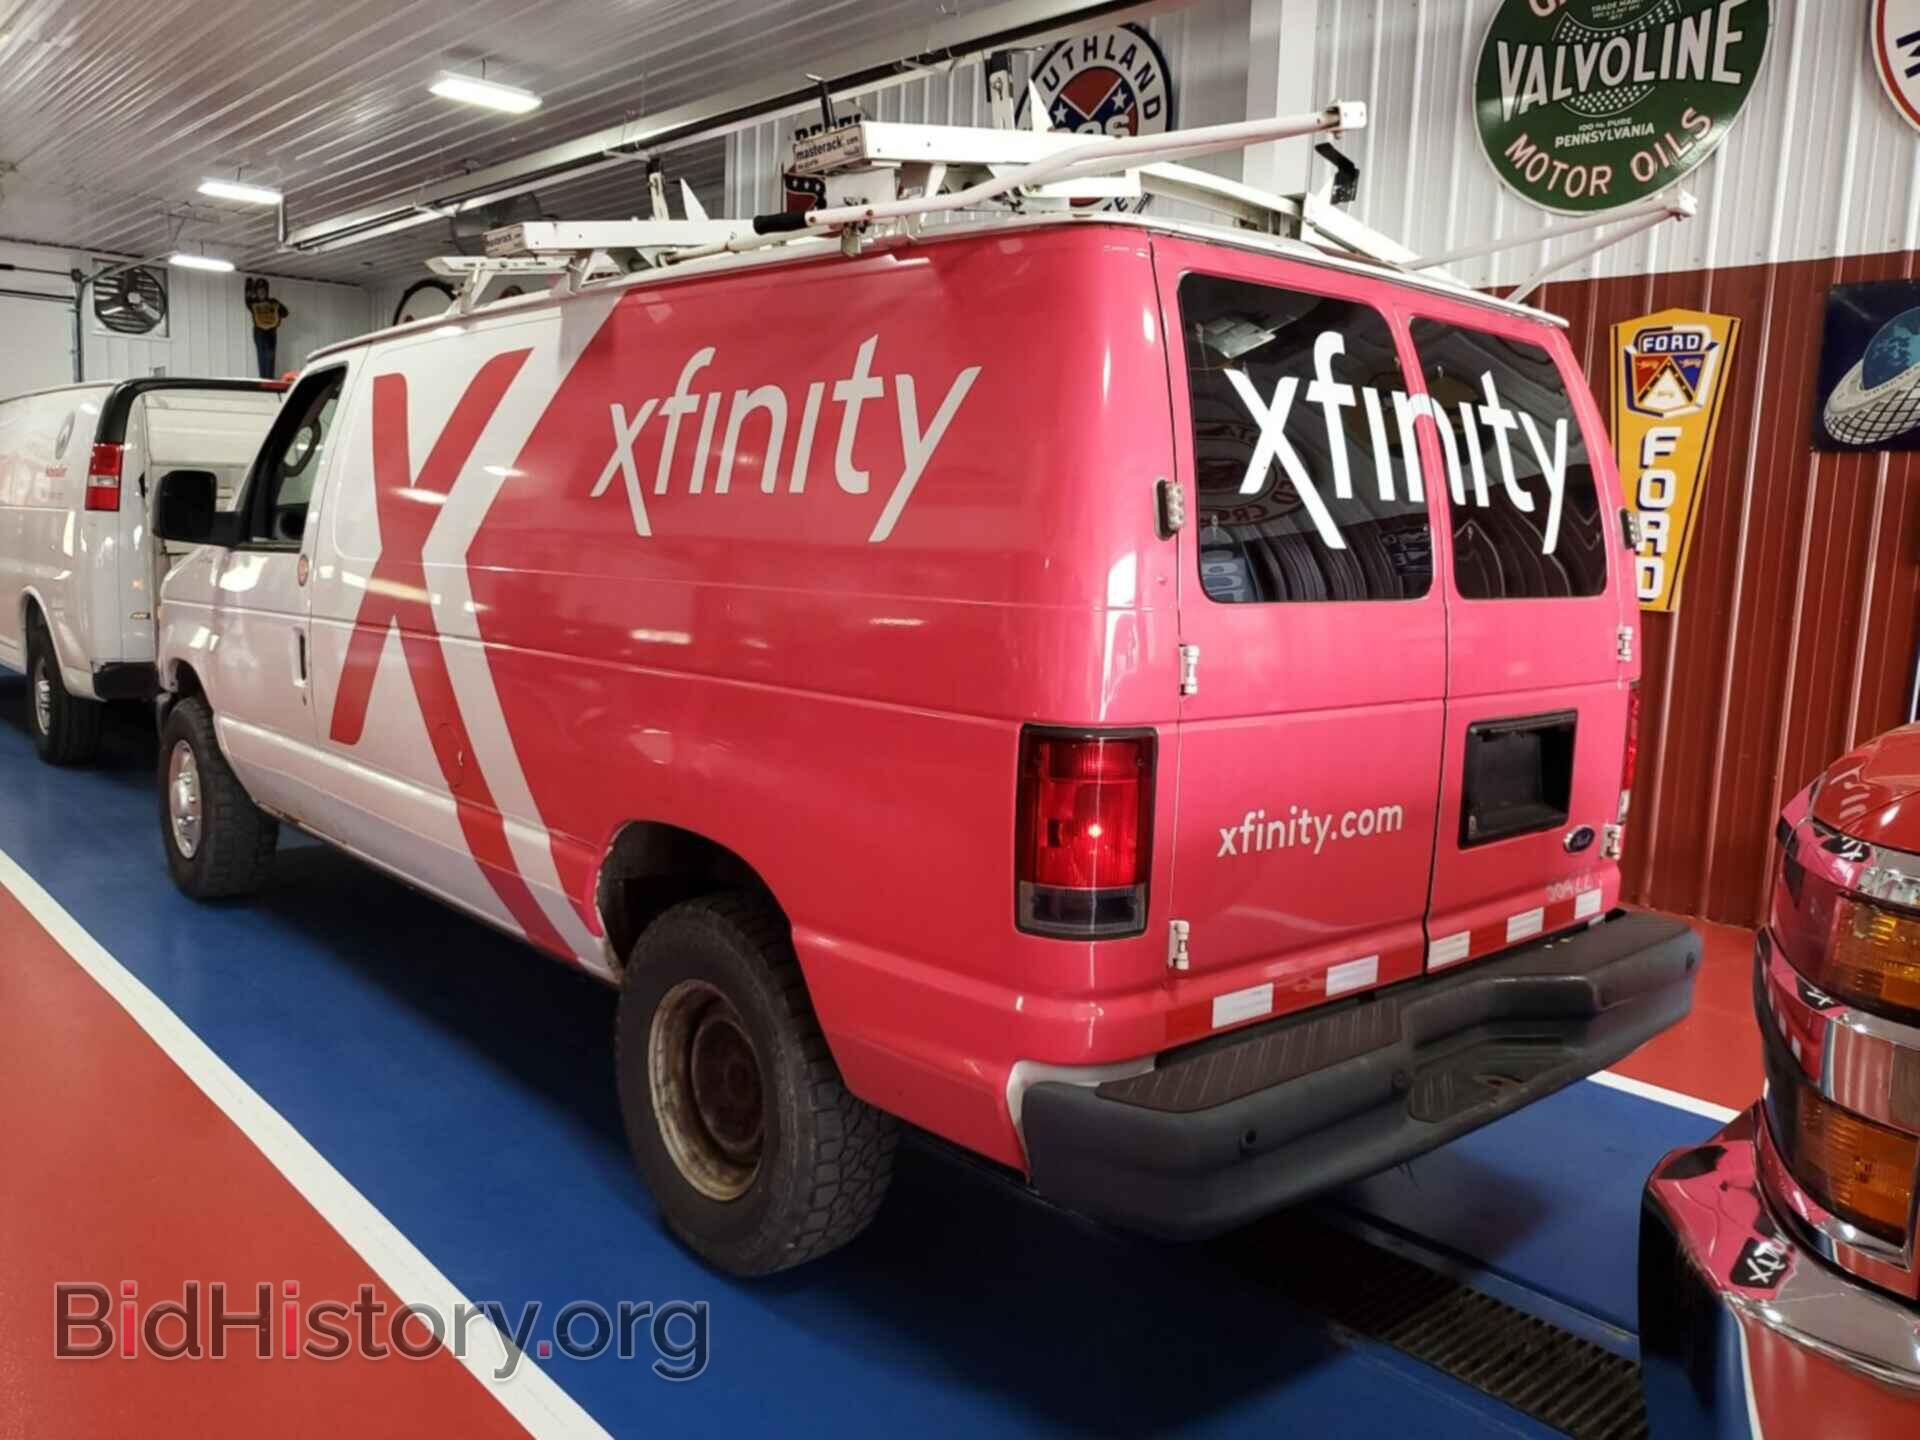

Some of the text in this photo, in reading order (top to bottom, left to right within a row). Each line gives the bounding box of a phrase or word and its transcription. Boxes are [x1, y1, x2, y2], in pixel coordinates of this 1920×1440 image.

[1043, 33, 1161, 120] UTHLAND
[1497, 0, 1747, 122] VALVOLINE
[1504, 106, 1715, 199] MOTOR OILS
[1554, 122, 1655, 148] PENNSYLVANIA
[1642, 333, 1701, 353] FORD
[589, 333, 983, 544] xfinity
[1223, 330, 1568, 555] xfinity
[1635, 425, 1683, 602] FORD
[1216, 803, 1404, 858] xfinity.com
